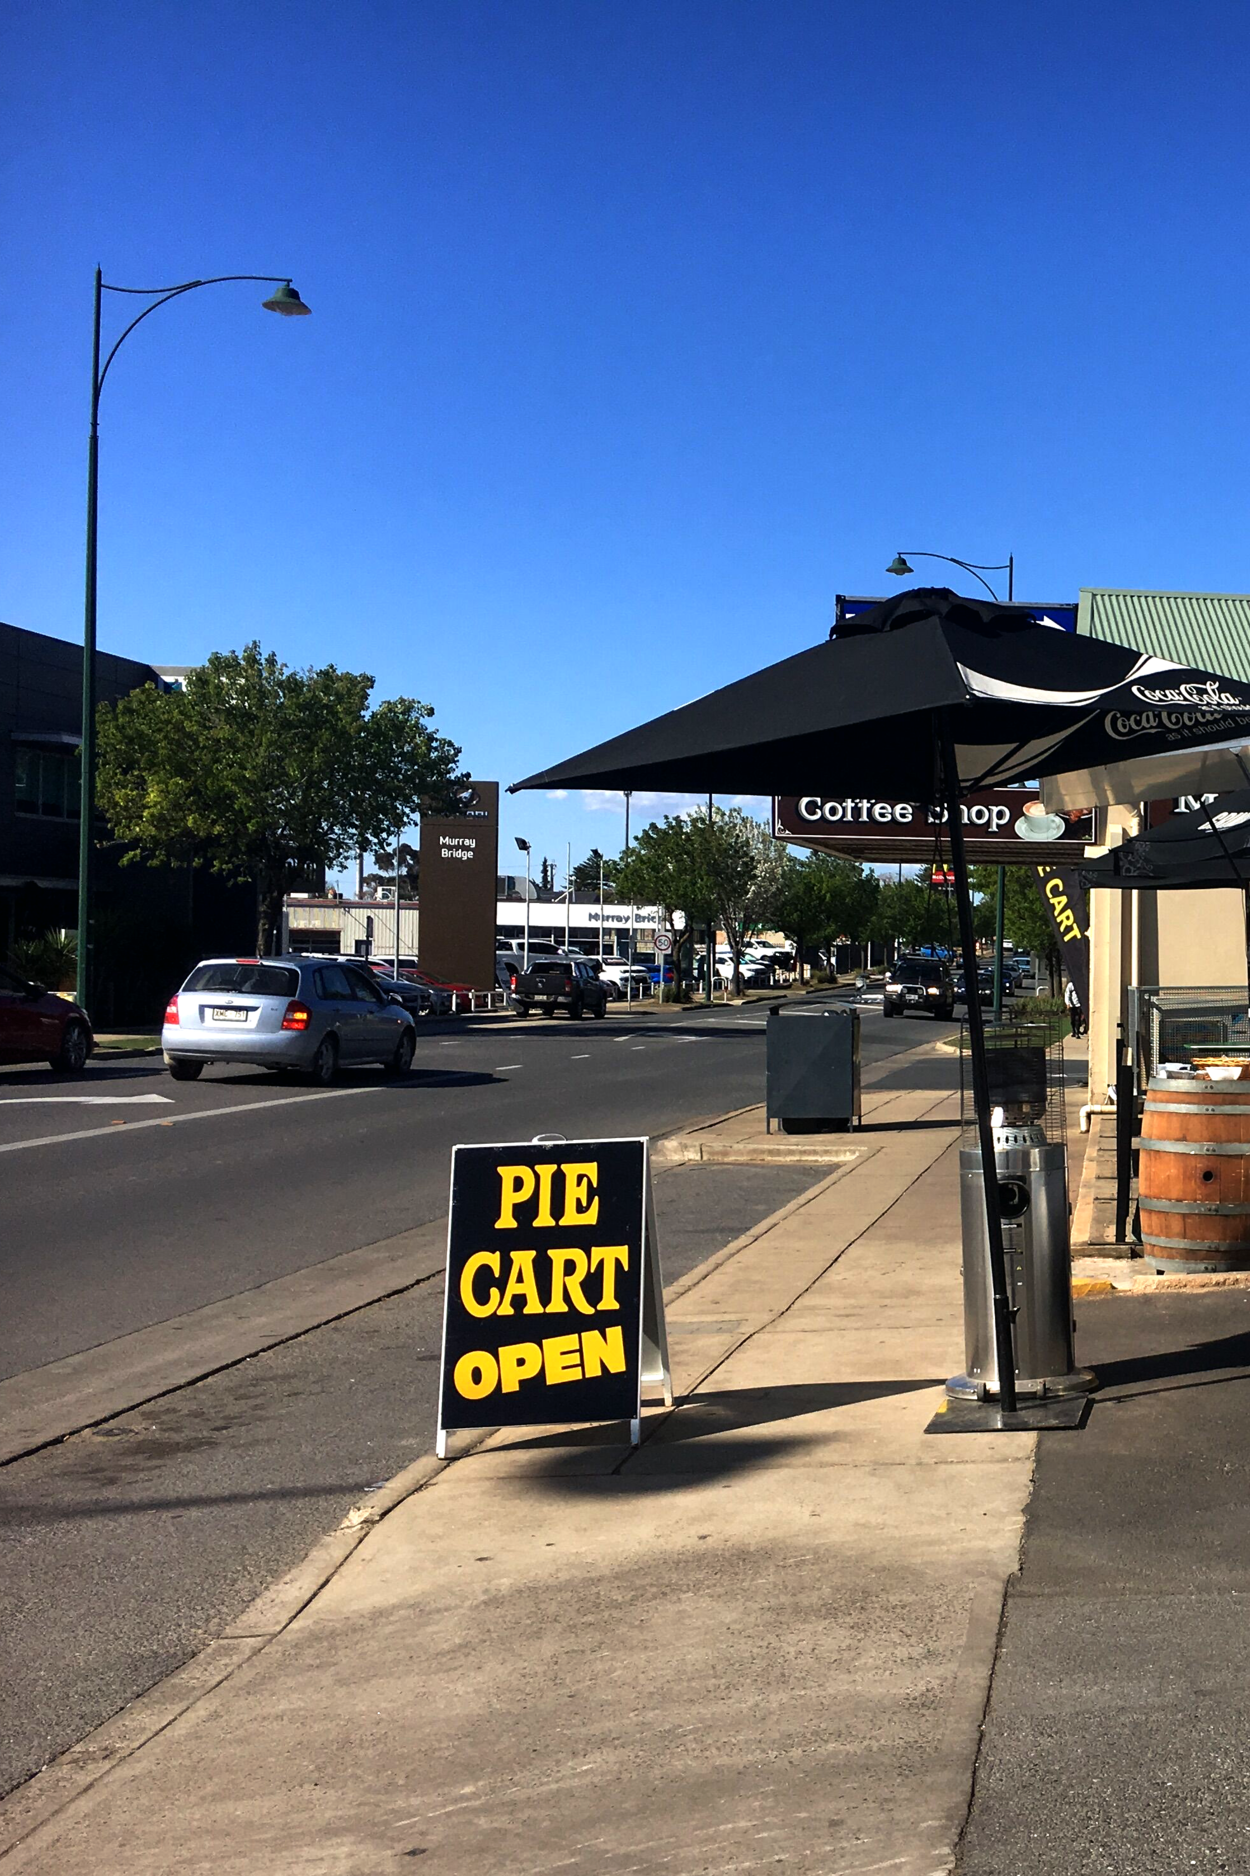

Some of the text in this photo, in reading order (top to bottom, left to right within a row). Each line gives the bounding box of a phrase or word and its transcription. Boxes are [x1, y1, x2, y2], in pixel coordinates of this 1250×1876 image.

[1165, 732, 1181, 741] as
[1182, 728, 1192, 737] it
[1193, 716, 1234, 735] should
[798, 797, 913, 823] Coffee
[439, 836, 476, 848] Murray
[441, 848, 474, 860] Bridge
[588, 912, 631, 924] Murray
[1046, 878, 1081, 942] CART
[658, 939, 668, 947] 50
[494, 1161, 599, 1229] PIE
[460, 1245, 629, 1318] CART
[453, 1325, 627, 1400] OPEN
